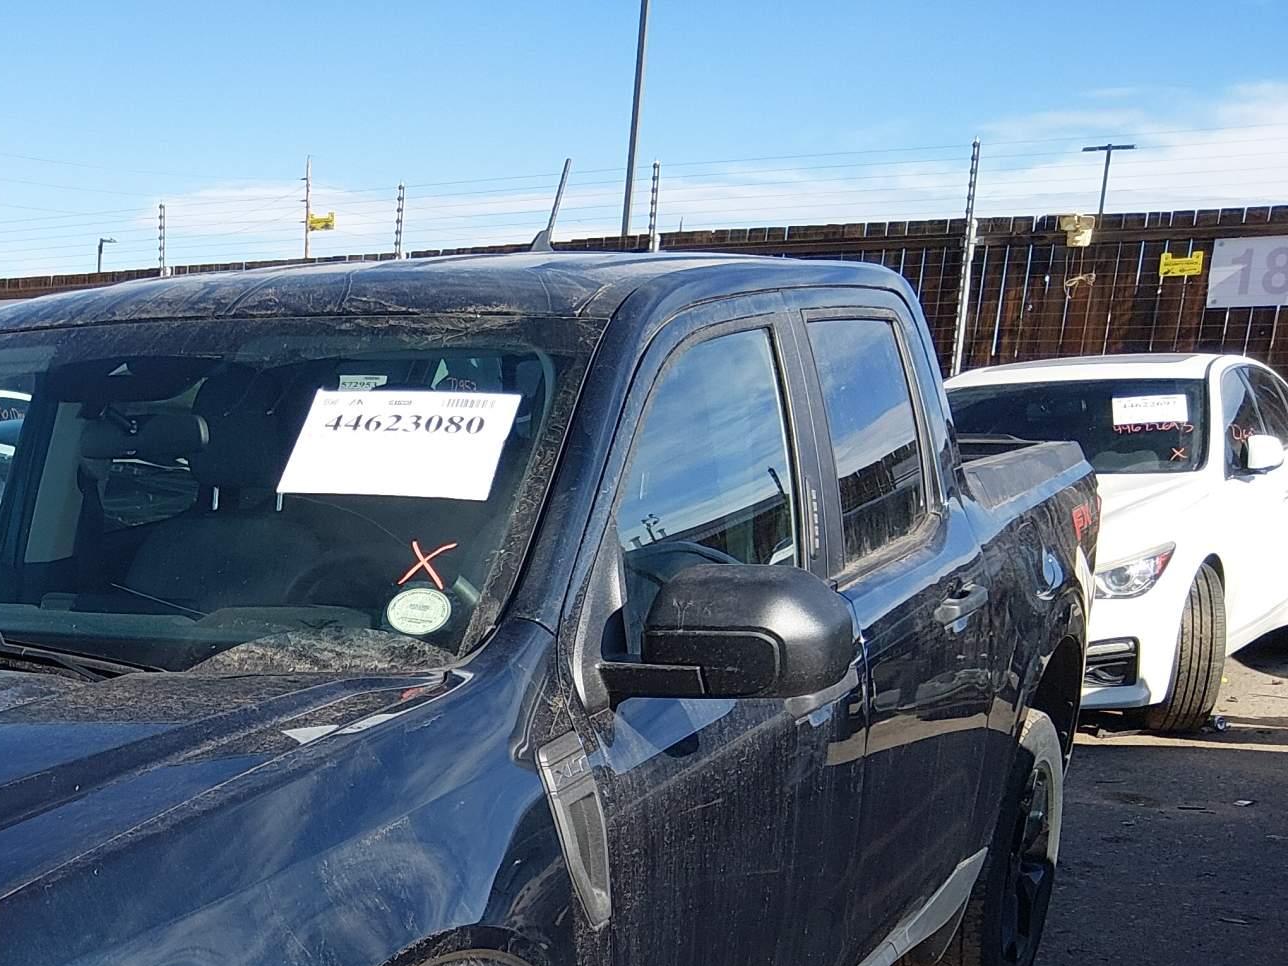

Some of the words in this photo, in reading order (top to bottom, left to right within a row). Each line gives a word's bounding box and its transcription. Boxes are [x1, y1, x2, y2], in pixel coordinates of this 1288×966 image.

[1231, 247, 1288, 295] 18
[324, 413, 485, 434] 44623080
[552, 754, 588, 787] XLT
